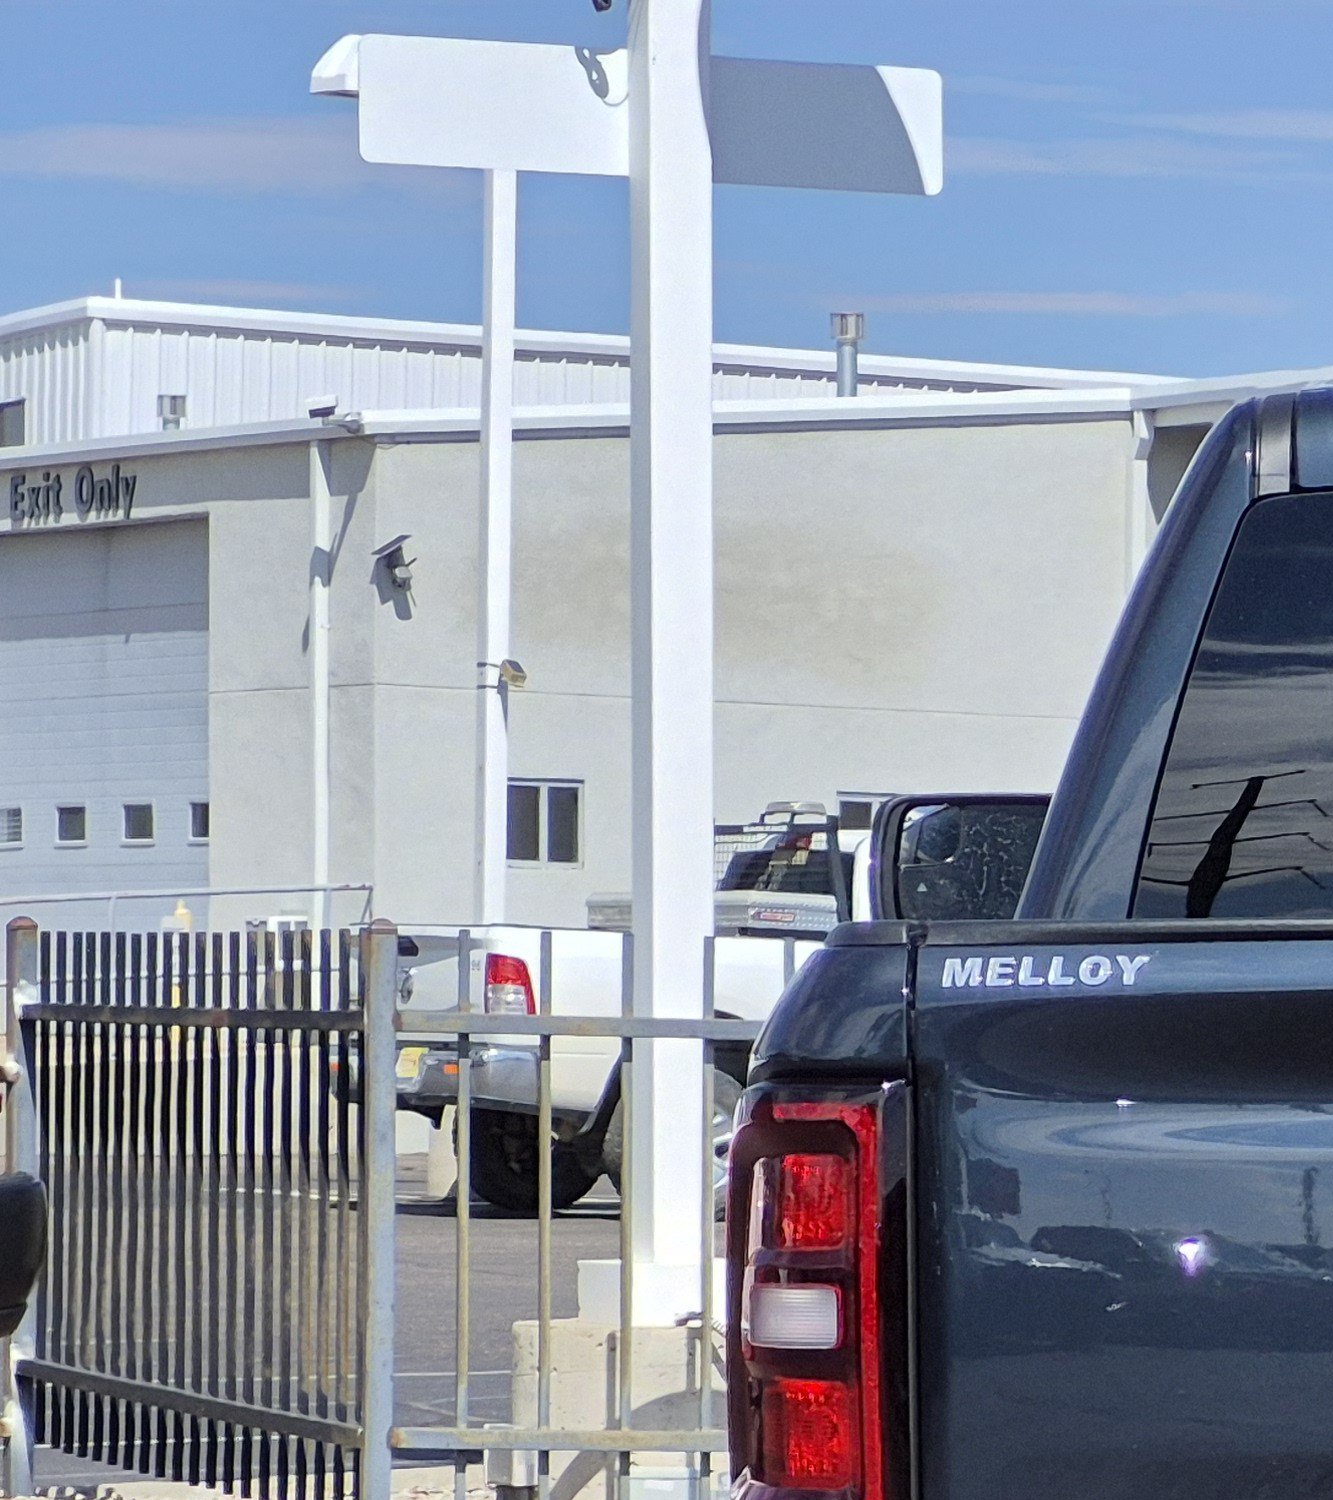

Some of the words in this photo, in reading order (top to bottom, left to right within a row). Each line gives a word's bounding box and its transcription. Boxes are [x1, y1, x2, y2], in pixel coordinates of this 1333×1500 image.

[10, 472, 63, 524] Exit
[75, 463, 137, 521] Only
[942, 954, 1151, 988] MELLOY
